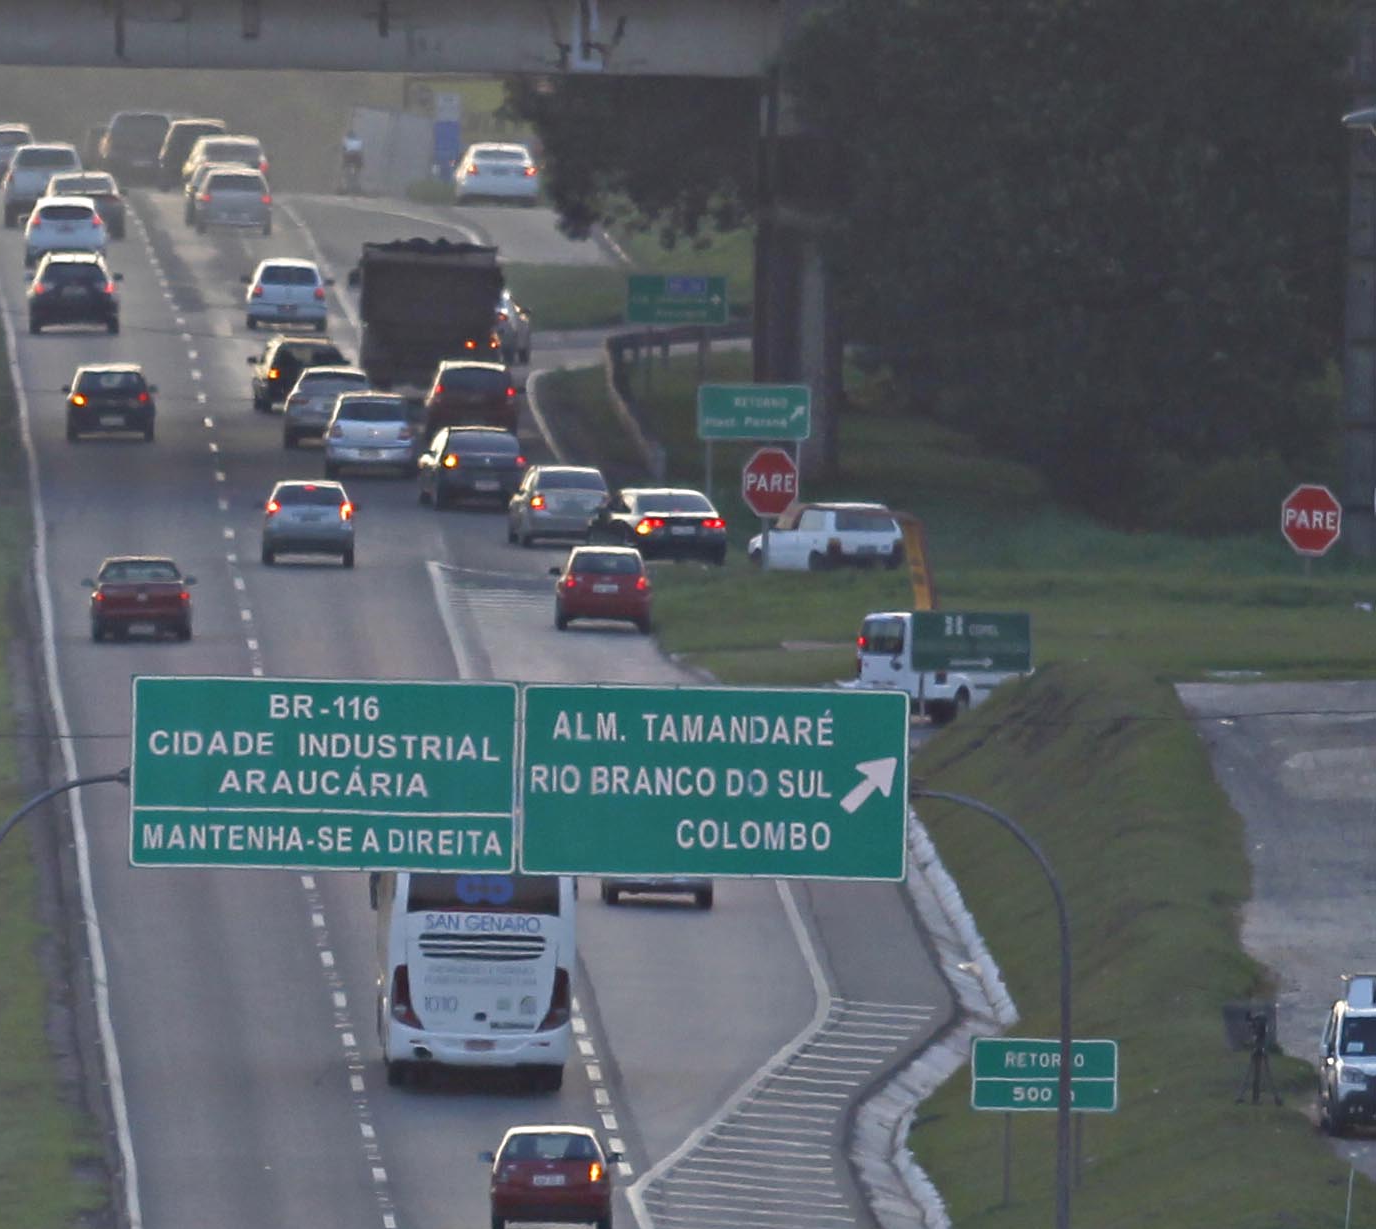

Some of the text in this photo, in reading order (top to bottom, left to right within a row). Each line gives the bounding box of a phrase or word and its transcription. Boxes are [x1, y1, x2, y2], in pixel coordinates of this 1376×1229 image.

[746, 473, 794, 493] PARE
[1284, 508, 1337, 531] PARE
[269, 694, 380, 721] BR-116
[552, 709, 834, 746] ALM. TAMANDARÉ
[149, 730, 501, 762] CIDADE INDUSTRIAL
[218, 765, 429, 798] ARAUCÁRIA
[530, 764, 832, 799] RIO BRANCO DO SUL
[142, 823, 502, 856] MANTENHA-SE A DIREITA
[676, 818, 831, 852] COLOMBO
[425, 914, 542, 933] SAN GENARO
[1004, 1051, 1085, 1069] RETORO
[1012, 1087, 1053, 1102] 500
